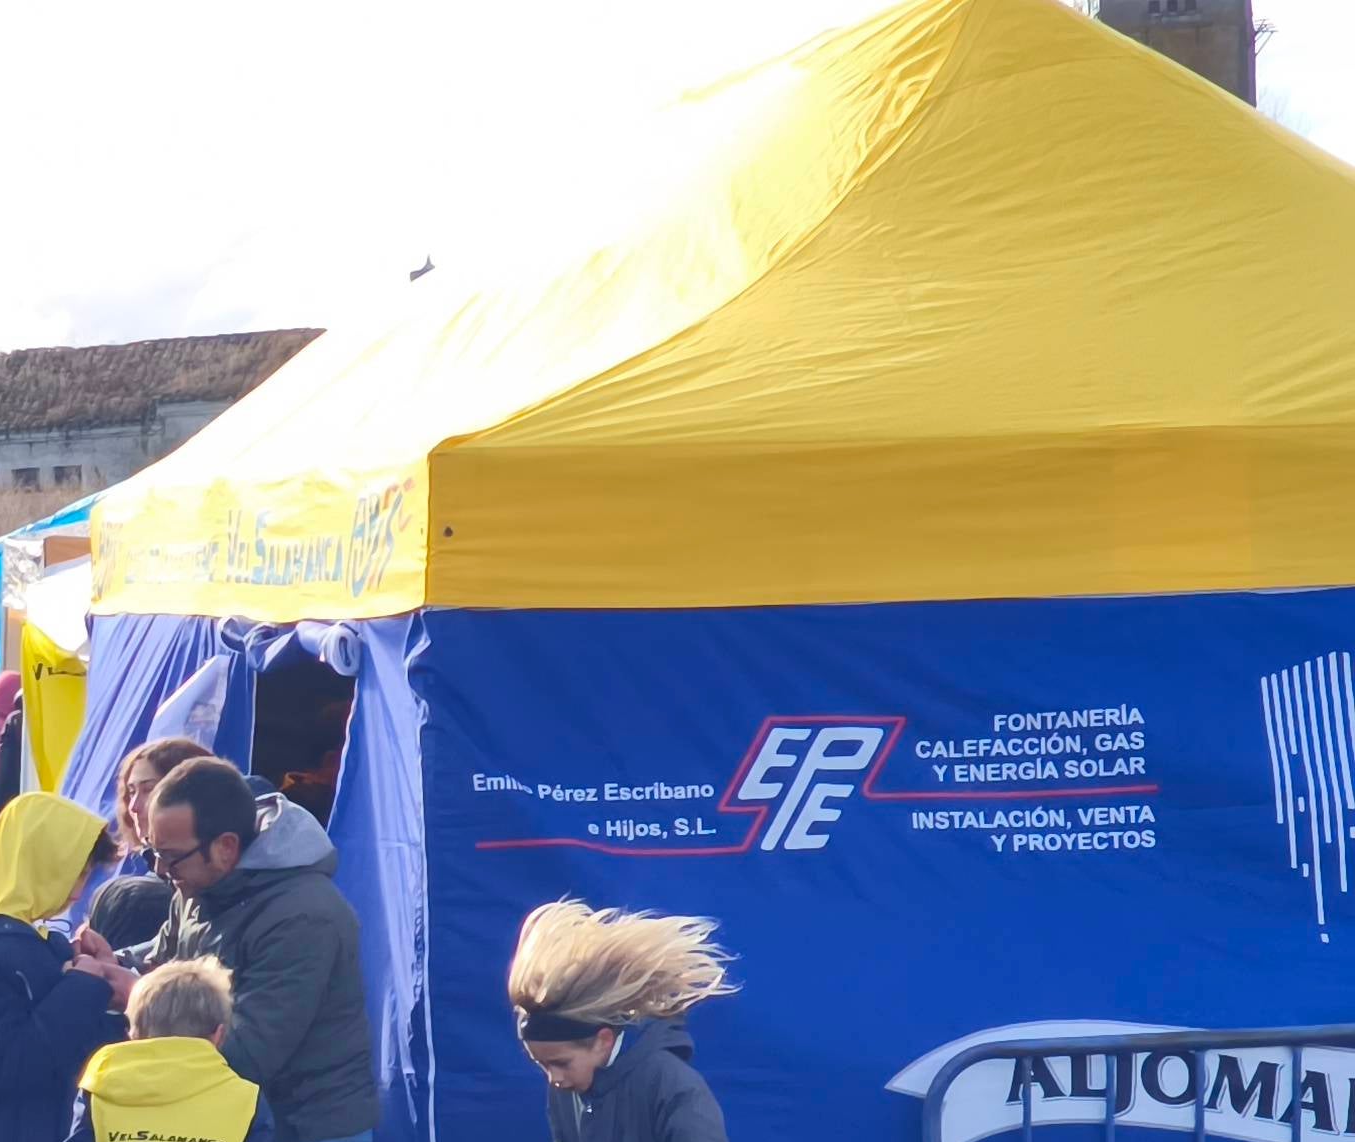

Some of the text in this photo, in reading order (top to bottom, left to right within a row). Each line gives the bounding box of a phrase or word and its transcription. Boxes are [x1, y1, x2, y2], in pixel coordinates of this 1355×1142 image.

[993, 704, 1145, 732] FONTANERÍA
[915, 731, 1145, 759] CALEFACCIÓN, GAS
[932, 756, 1146, 783] Y ENERGÍA SOLAR
[537, 784, 598, 802] Pérez
[604, 782, 715, 801] Escribano
[605, 819, 668, 841] Hijos,
[911, 805, 1156, 830] INSTALACIÓN, VENTA
[991, 829, 1157, 853] Y PROYECTOS
[1005, 1050, 1355, 1136] ALJOMA
